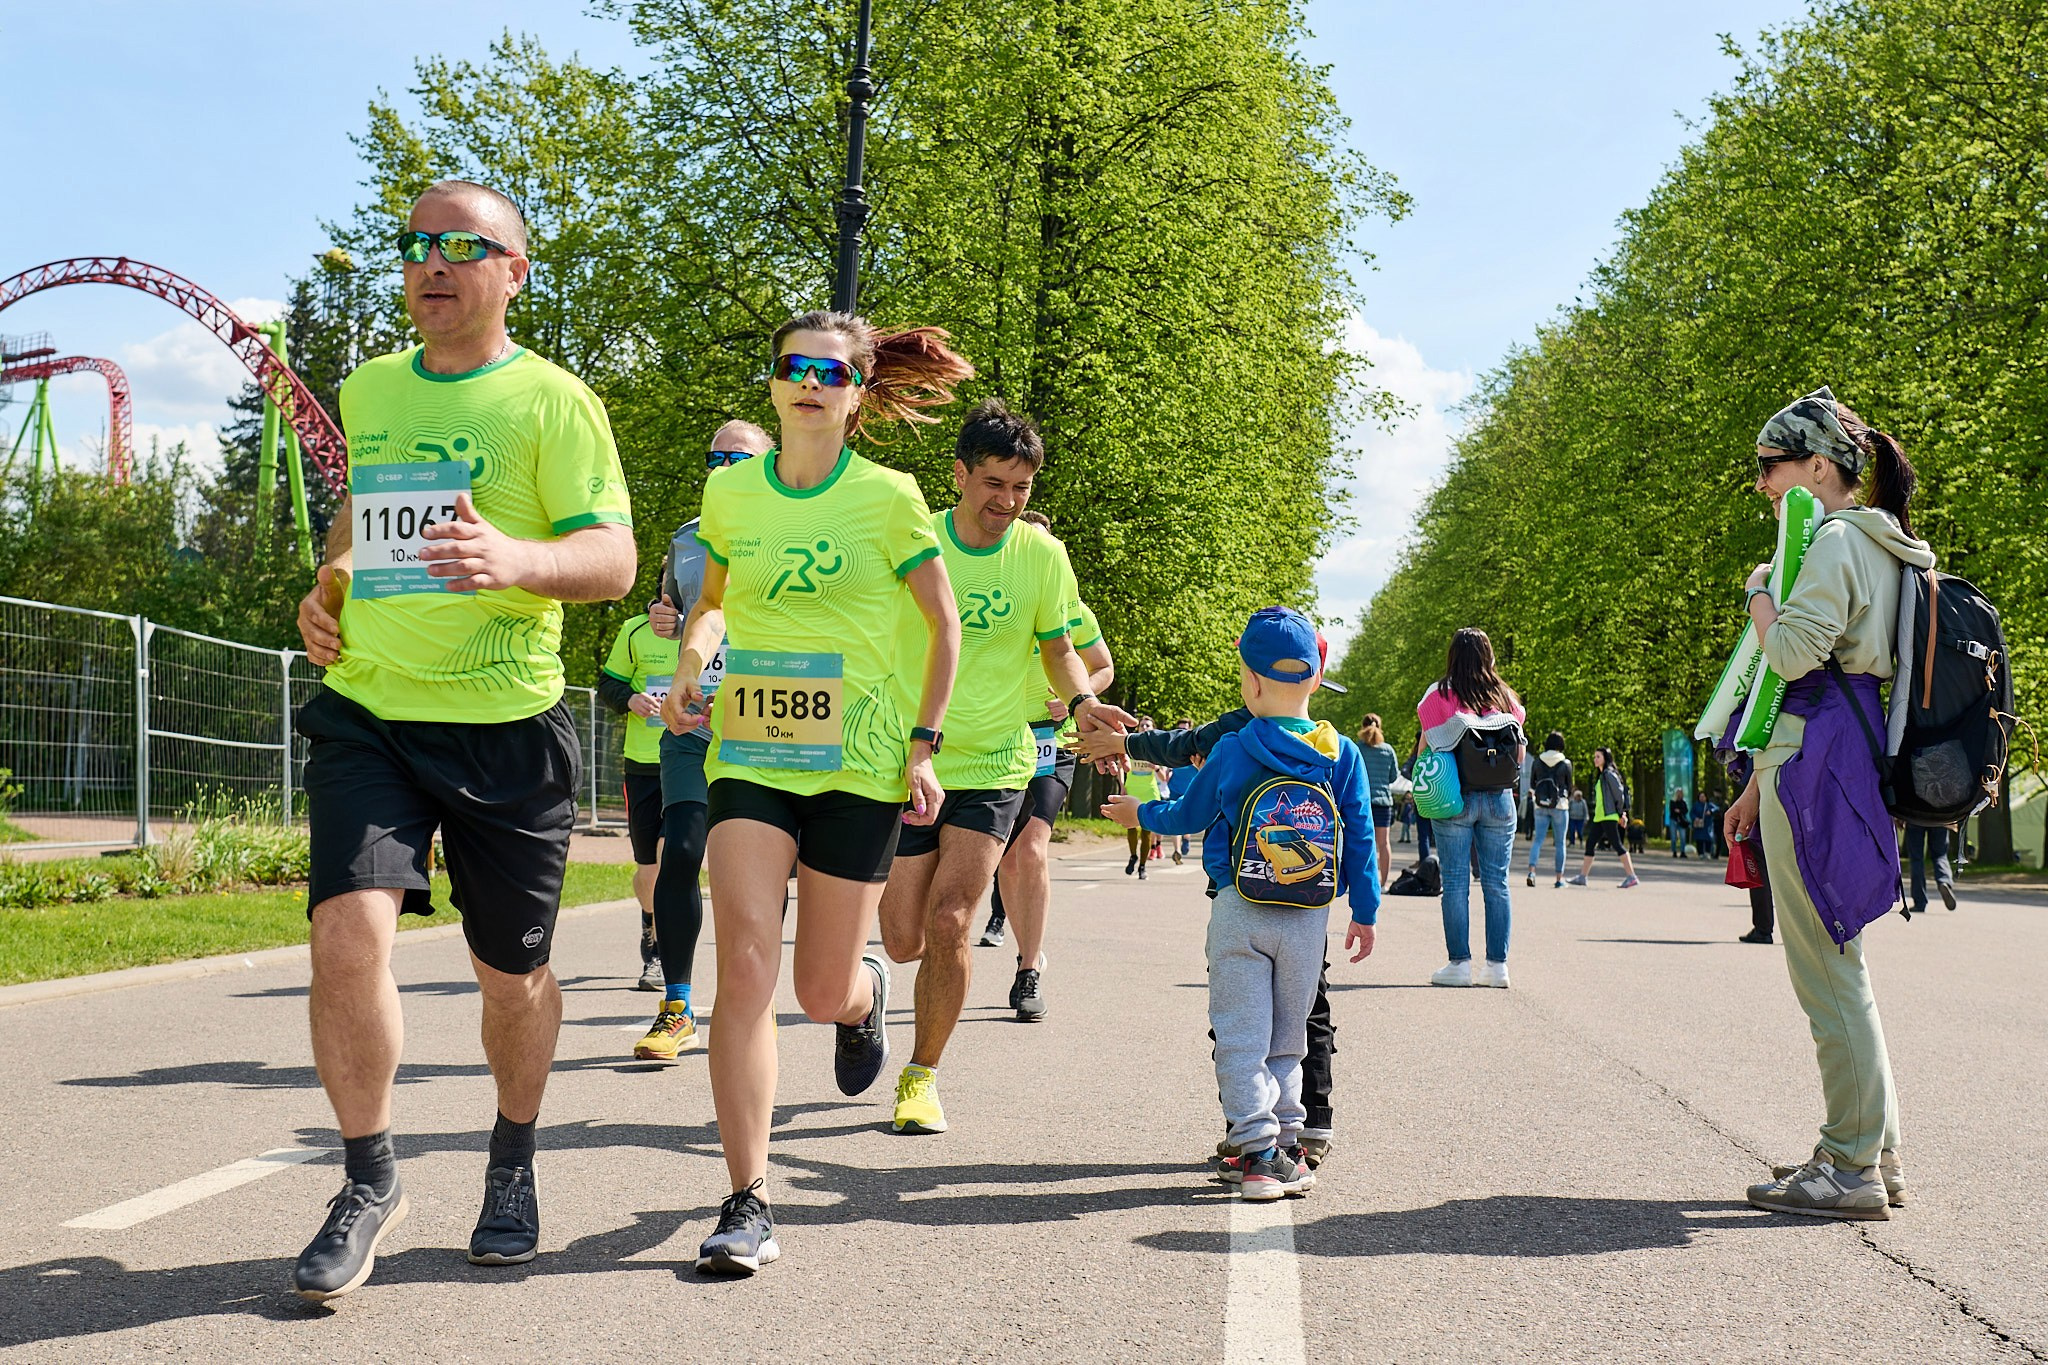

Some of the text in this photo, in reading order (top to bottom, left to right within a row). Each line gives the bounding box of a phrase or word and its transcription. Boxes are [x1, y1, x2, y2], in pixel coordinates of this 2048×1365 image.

[390, 548, 405, 562] 10
[735, 687, 831, 720] 11588
[765, 725, 780, 738] 10
[1295, 821, 1321, 831] RACING
